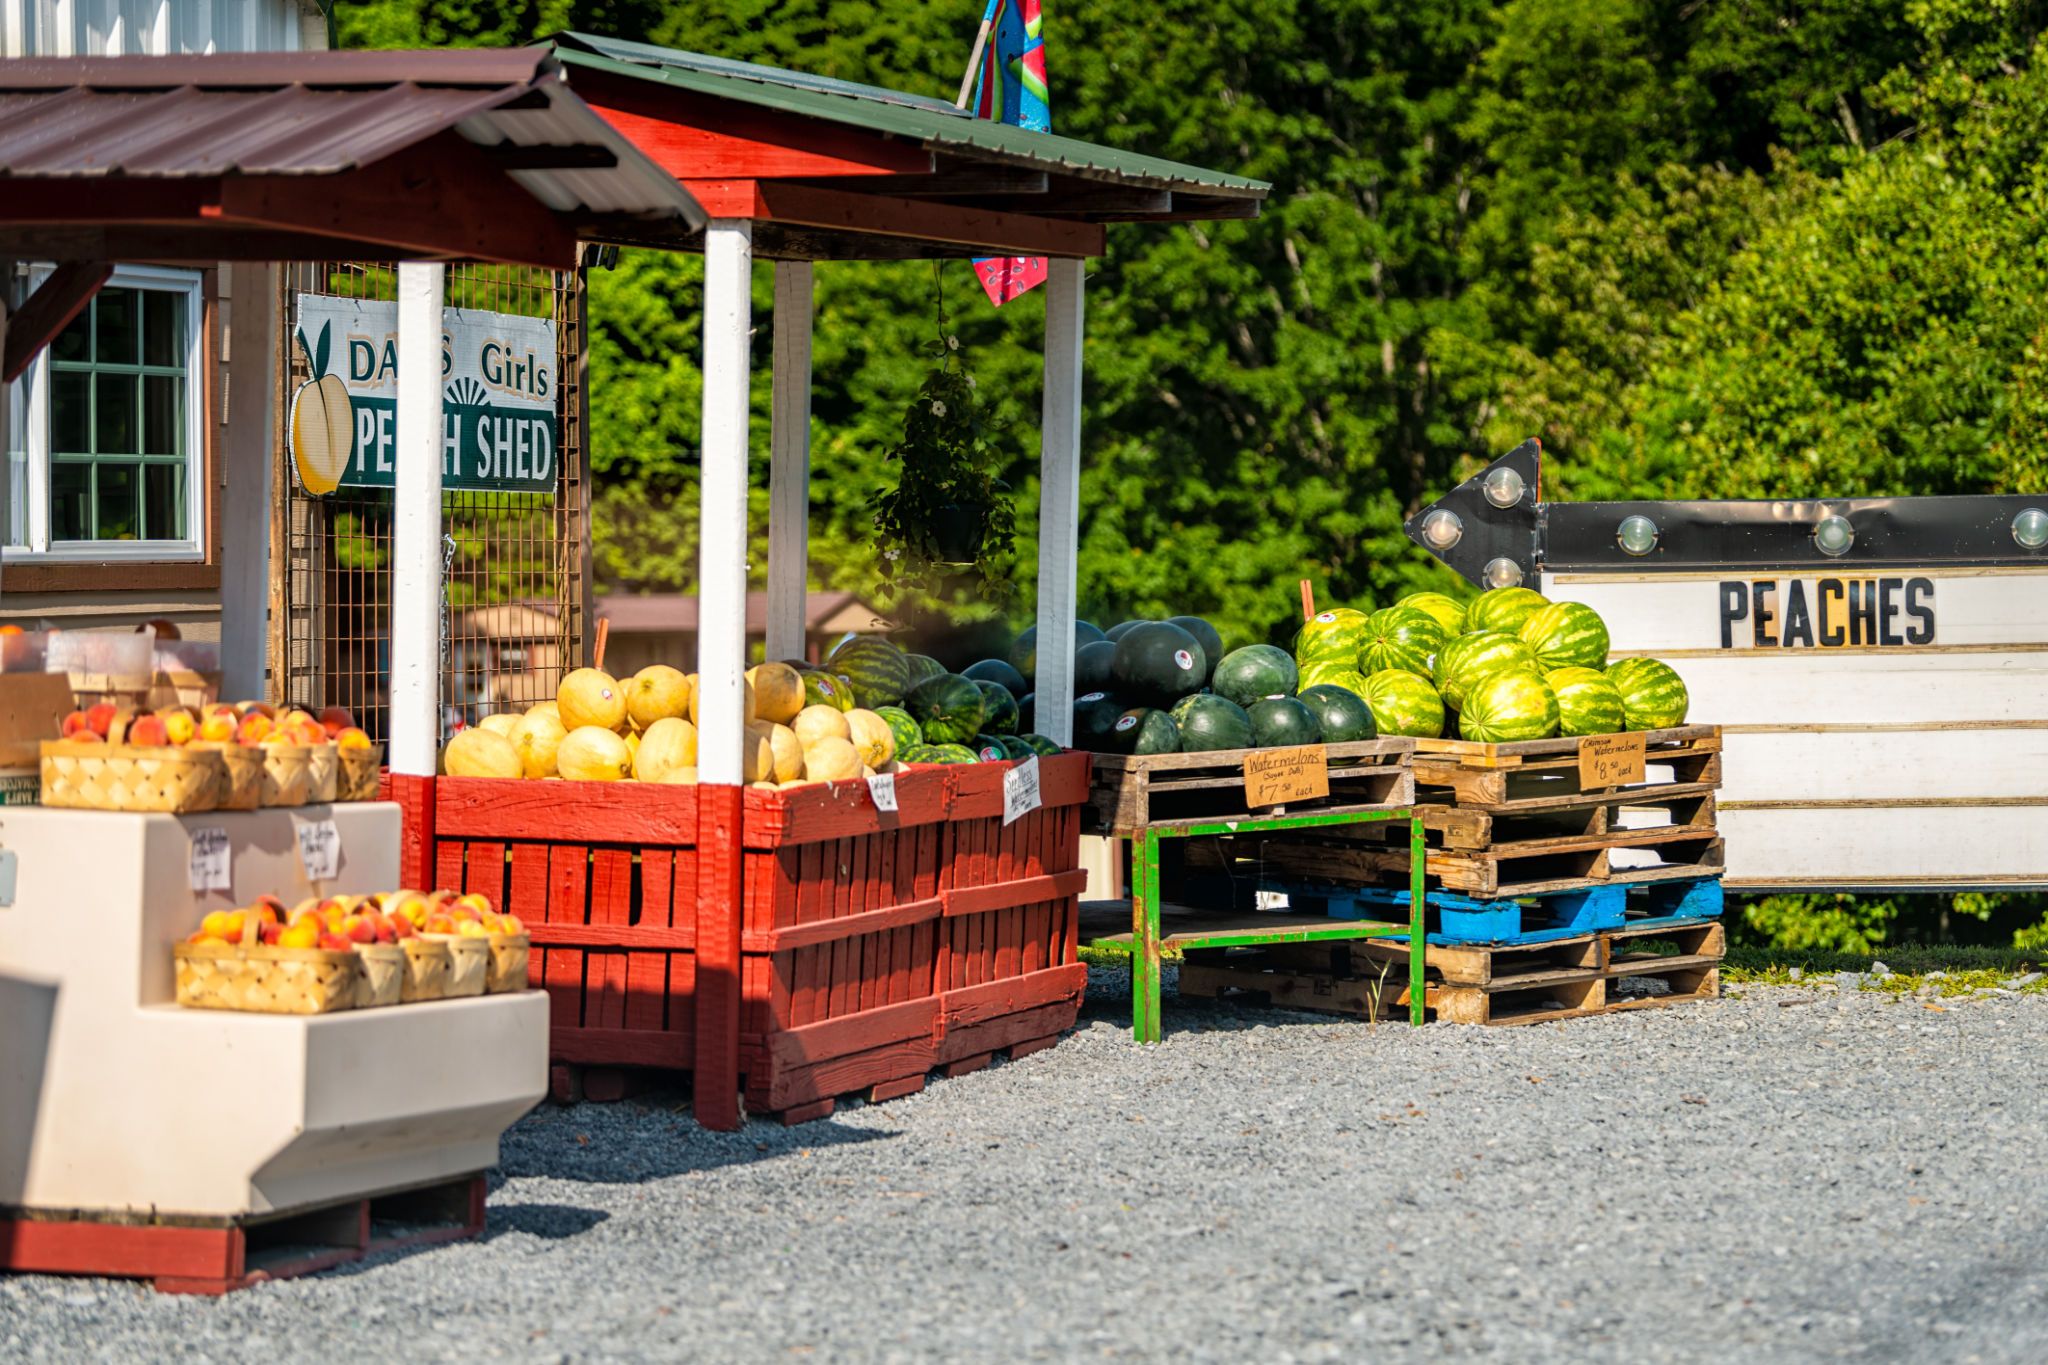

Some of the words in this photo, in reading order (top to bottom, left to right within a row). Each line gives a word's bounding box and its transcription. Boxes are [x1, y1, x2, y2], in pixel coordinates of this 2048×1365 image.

[481, 342, 547, 397] Girls
[356, 407, 461, 476] PEH
[477, 415, 551, 480] SHED
[1719, 577, 1935, 649] PEACHES
[1249, 748, 1319, 772] Watermelons
